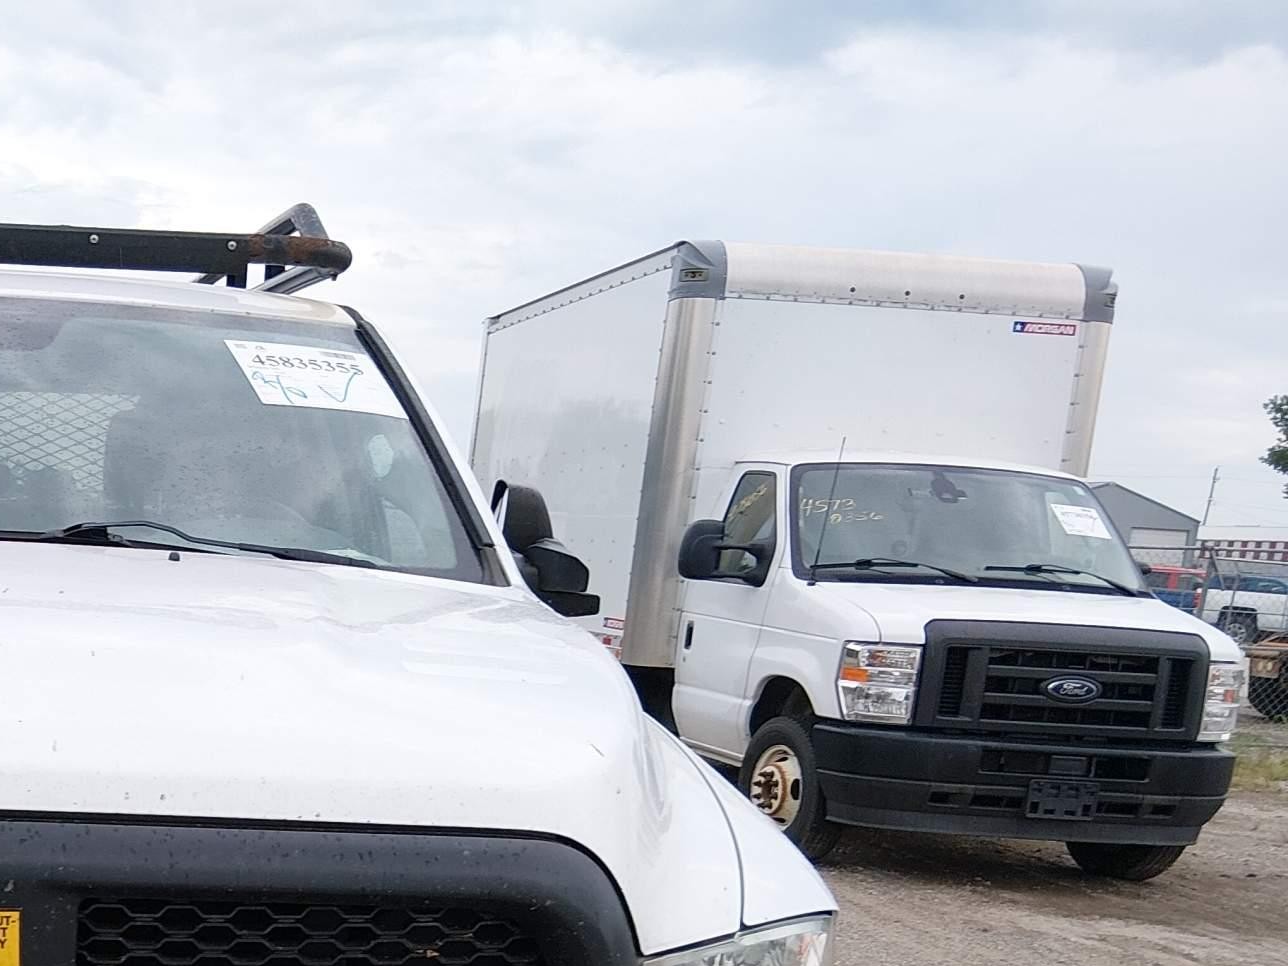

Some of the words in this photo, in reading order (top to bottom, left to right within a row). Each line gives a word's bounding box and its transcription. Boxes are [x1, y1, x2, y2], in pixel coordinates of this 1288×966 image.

[1023, 323, 1074, 335] MORGAN
[252, 353, 364, 375] 45835355
[800, 498, 856, 516] 4573
[1059, 682, 1089, 696] Ford
